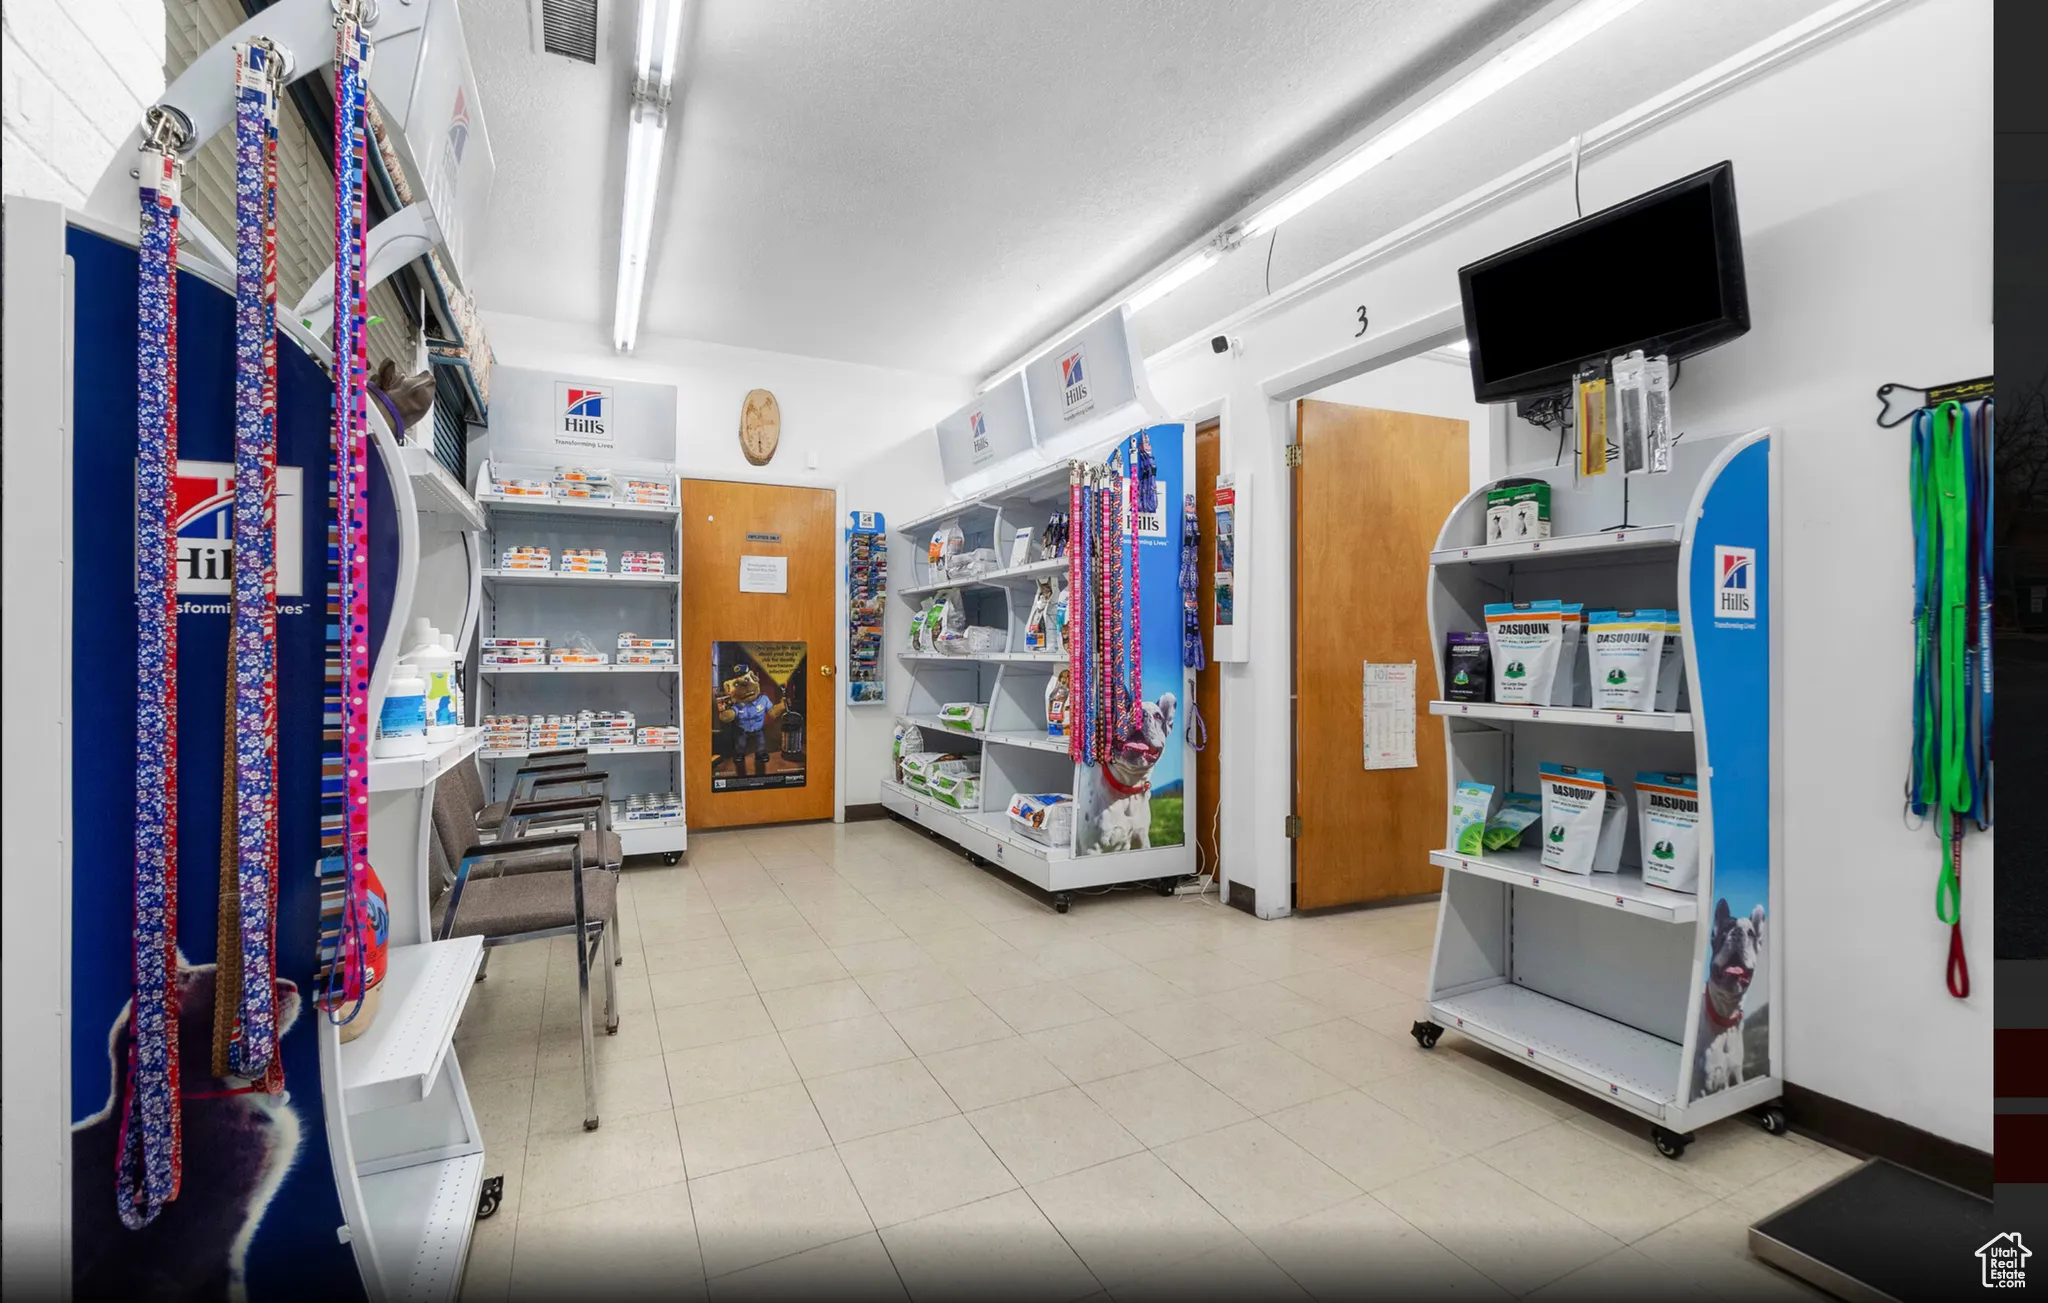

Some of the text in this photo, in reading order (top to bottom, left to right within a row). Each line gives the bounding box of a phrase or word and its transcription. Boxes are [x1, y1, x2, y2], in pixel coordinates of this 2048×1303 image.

[235, 68, 243, 84] TUFF
[1355, 305, 1369, 338] 3
[1065, 384, 1088, 407] Hill's
[565, 417, 605, 435] Hill's
[555, 439, 597, 449] Transforming
[1721, 592, 1750, 612] Hill's
[1498, 623, 1550, 636] DASUQUIN
[1596, 632, 1650, 643] DASUQUIN
[1552, 784, 1596, 801] DASUQUIN
[1650, 794, 1698, 813] DASUQUI
